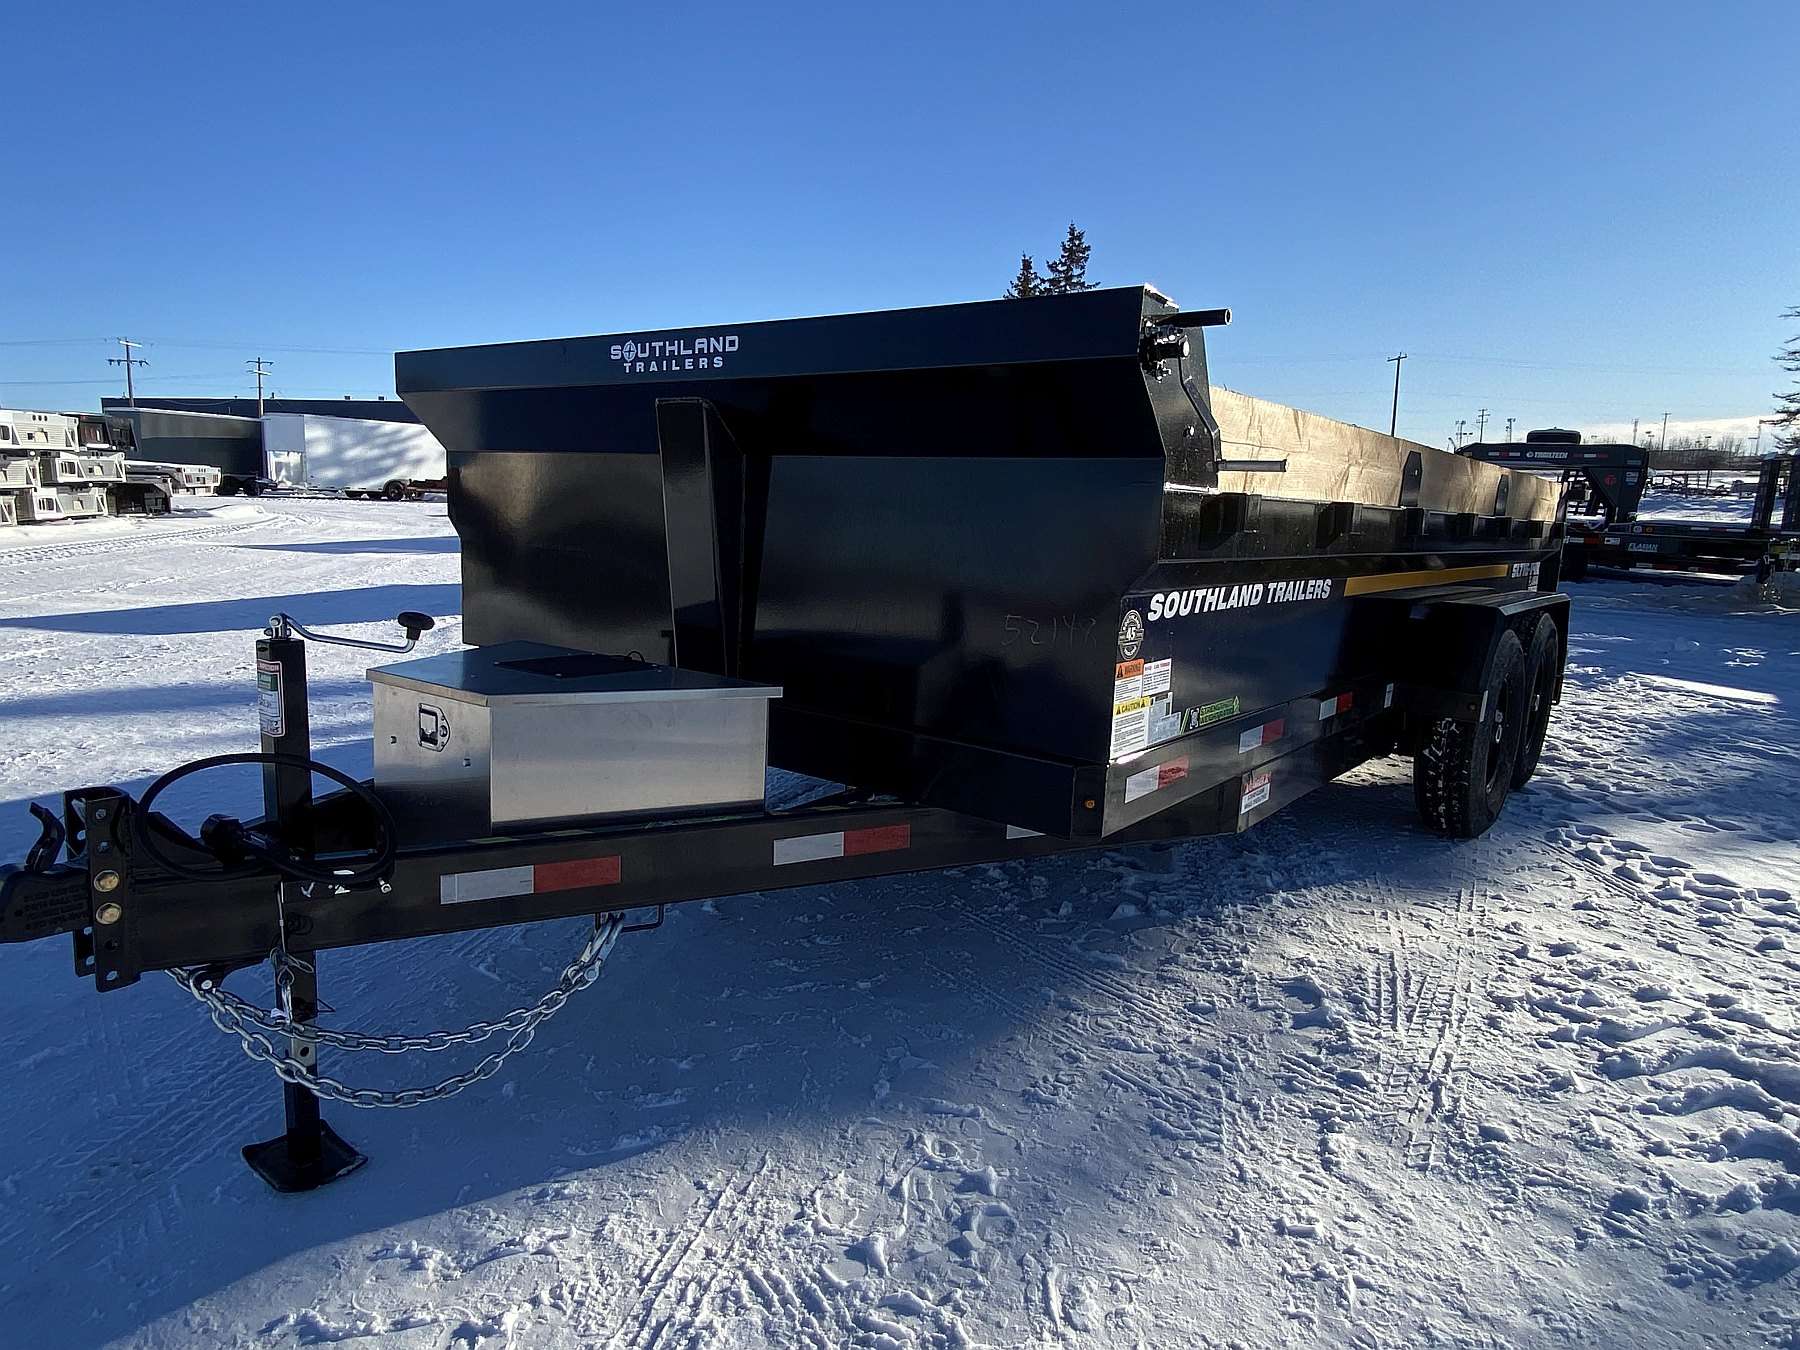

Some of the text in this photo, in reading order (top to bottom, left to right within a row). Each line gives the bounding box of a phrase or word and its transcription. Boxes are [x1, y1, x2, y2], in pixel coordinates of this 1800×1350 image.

[610, 335, 739, 361] SOUTHLAND
[623, 356, 723, 373] TRAILERS
[1147, 578, 1332, 621] SOUTHLAND TRAILERS
